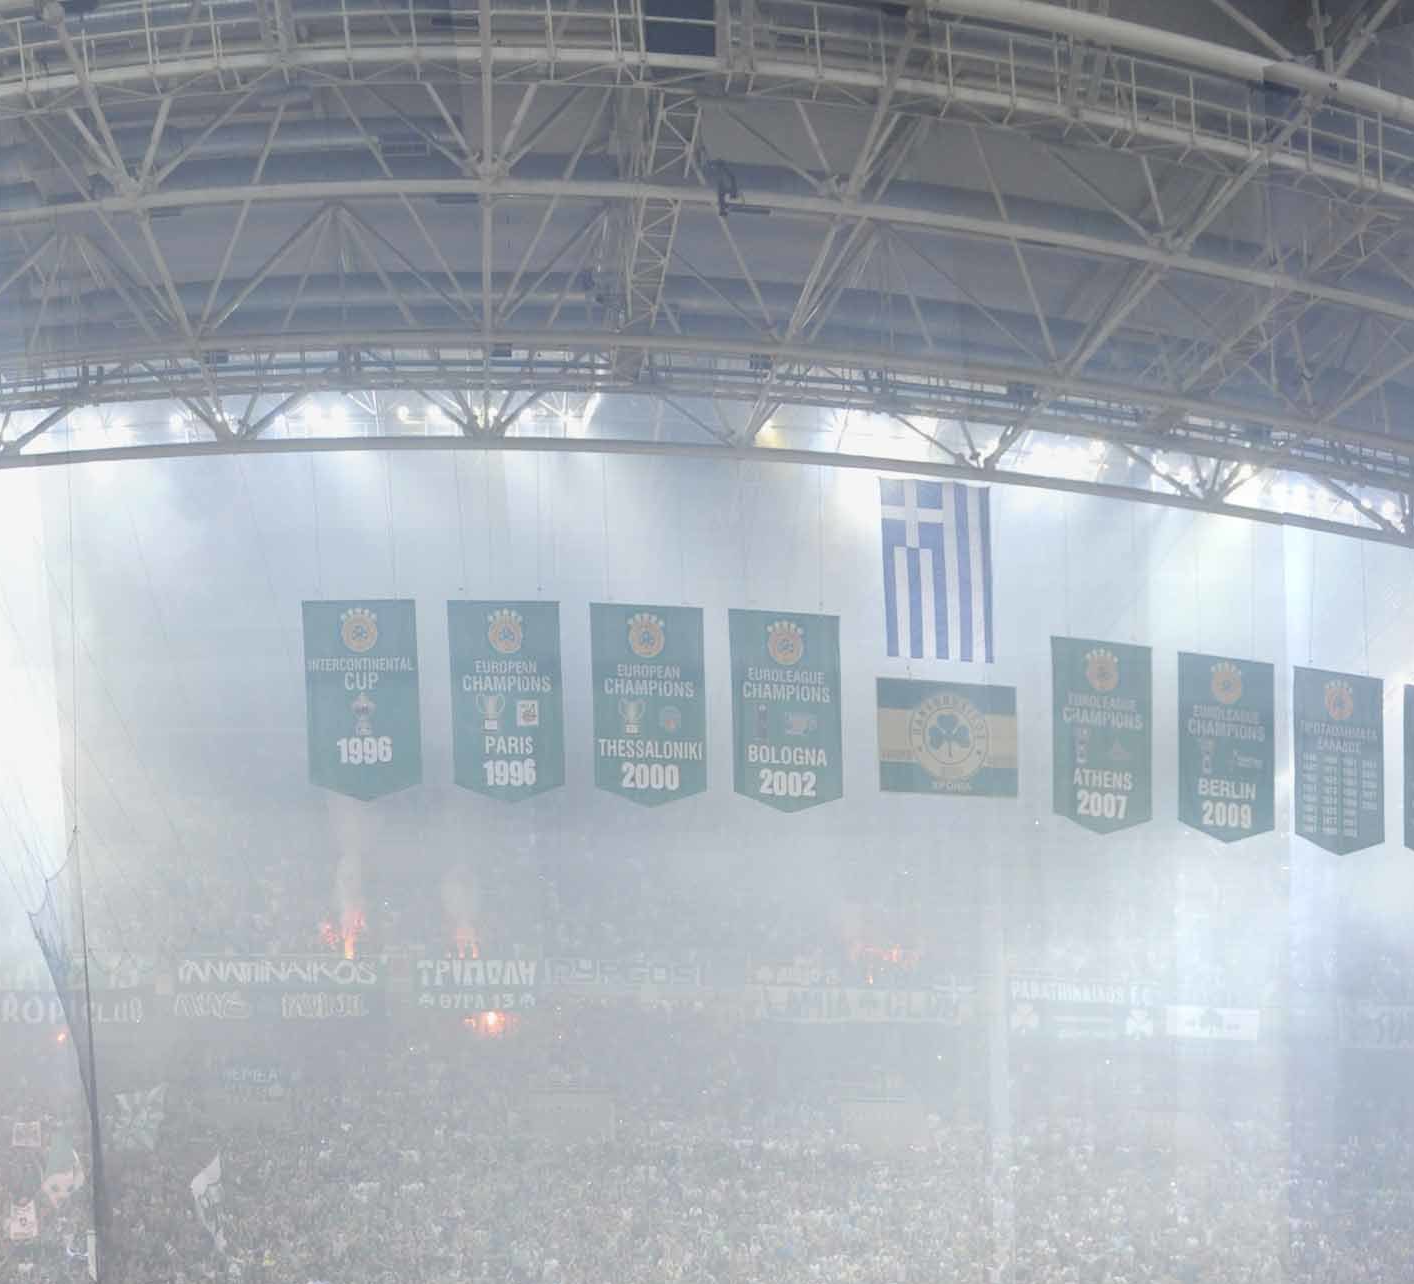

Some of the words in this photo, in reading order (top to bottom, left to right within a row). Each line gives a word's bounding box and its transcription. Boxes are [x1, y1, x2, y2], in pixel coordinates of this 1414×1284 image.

[307, 657, 414, 672] INTERCONTINENTAL
[473, 660, 537, 674] EUROPEAN
[616, 664, 680, 679] EUROPEAN
[748, 667, 825, 685] EUROLEAGUE
[344, 672, 379, 691] CUP
[462, 674, 552, 692] CHAMPIONS
[604, 678, 694, 697] CHAMPIONS
[743, 681, 831, 703] CHAMPIONS
[1063, 708, 1144, 731] CHAMPIONS
[1187, 718, 1266, 743] CHAMPIONS
[336, 736, 392, 764] 1996
[484, 736, 533, 754] PARIS
[598, 738, 703, 761] THESSALONIKI
[747, 744, 828, 767] BOLOGNA
[482, 758, 536, 786] 1996
[621, 762, 680, 791] 2000
[759, 768, 817, 797] 2002
[1073, 768, 1133, 791] ATHENS
[1197, 777, 1256, 801] BERLIN
[1076, 789, 1128, 820] 2007
[1202, 800, 1252, 829] 2009
